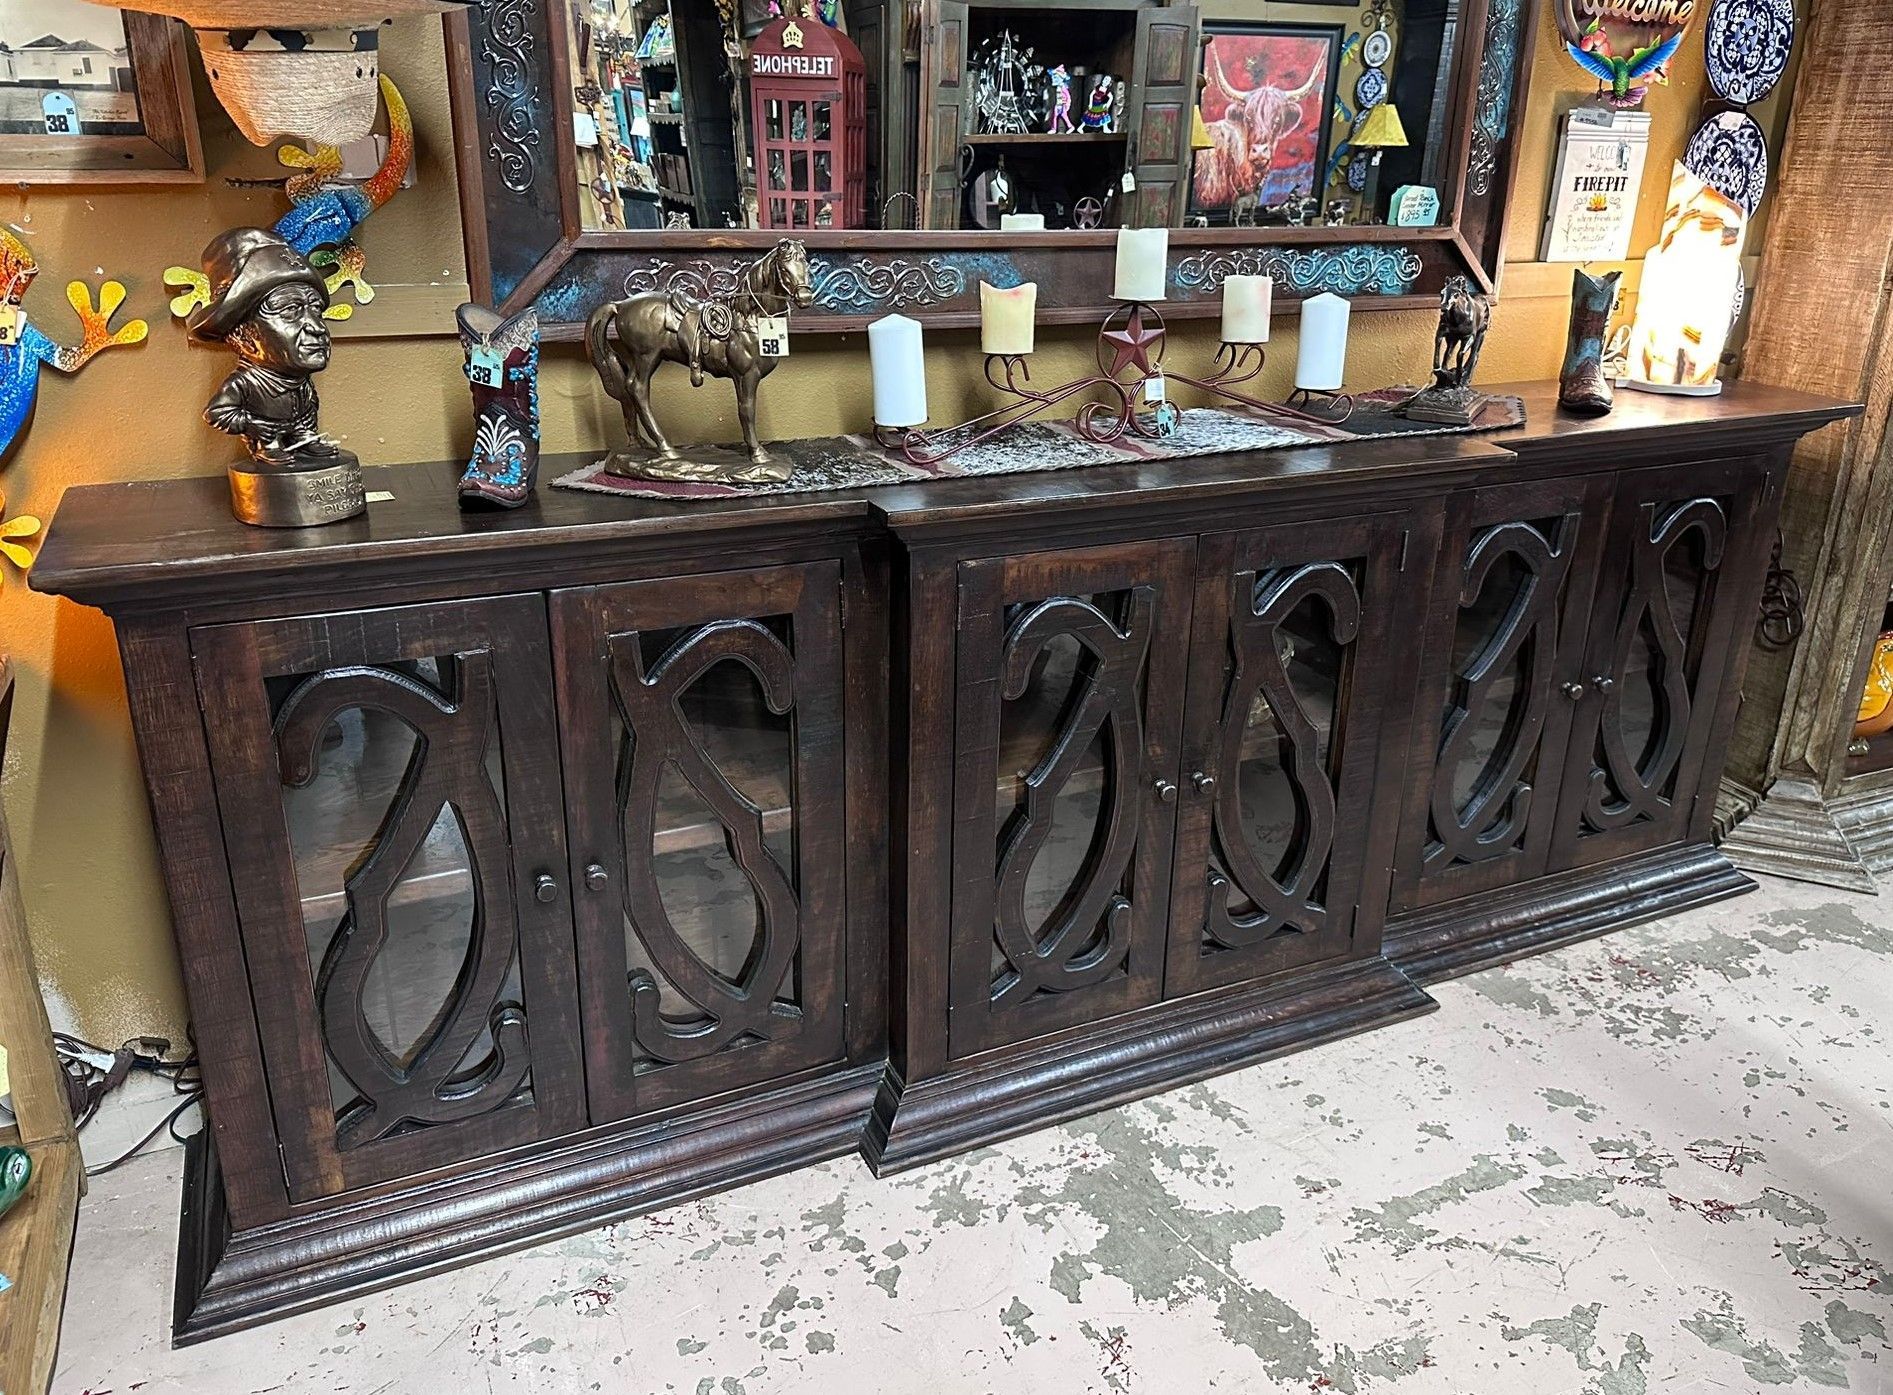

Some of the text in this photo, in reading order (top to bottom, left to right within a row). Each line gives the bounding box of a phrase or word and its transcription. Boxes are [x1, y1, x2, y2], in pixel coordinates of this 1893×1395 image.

[46, 115, 70, 132] 38
[1573, 176, 1629, 192] FIREPIT
[762, 339, 779, 354] 58
[473, 365, 492, 384] 38
[306, 473, 343, 490] SMILE
